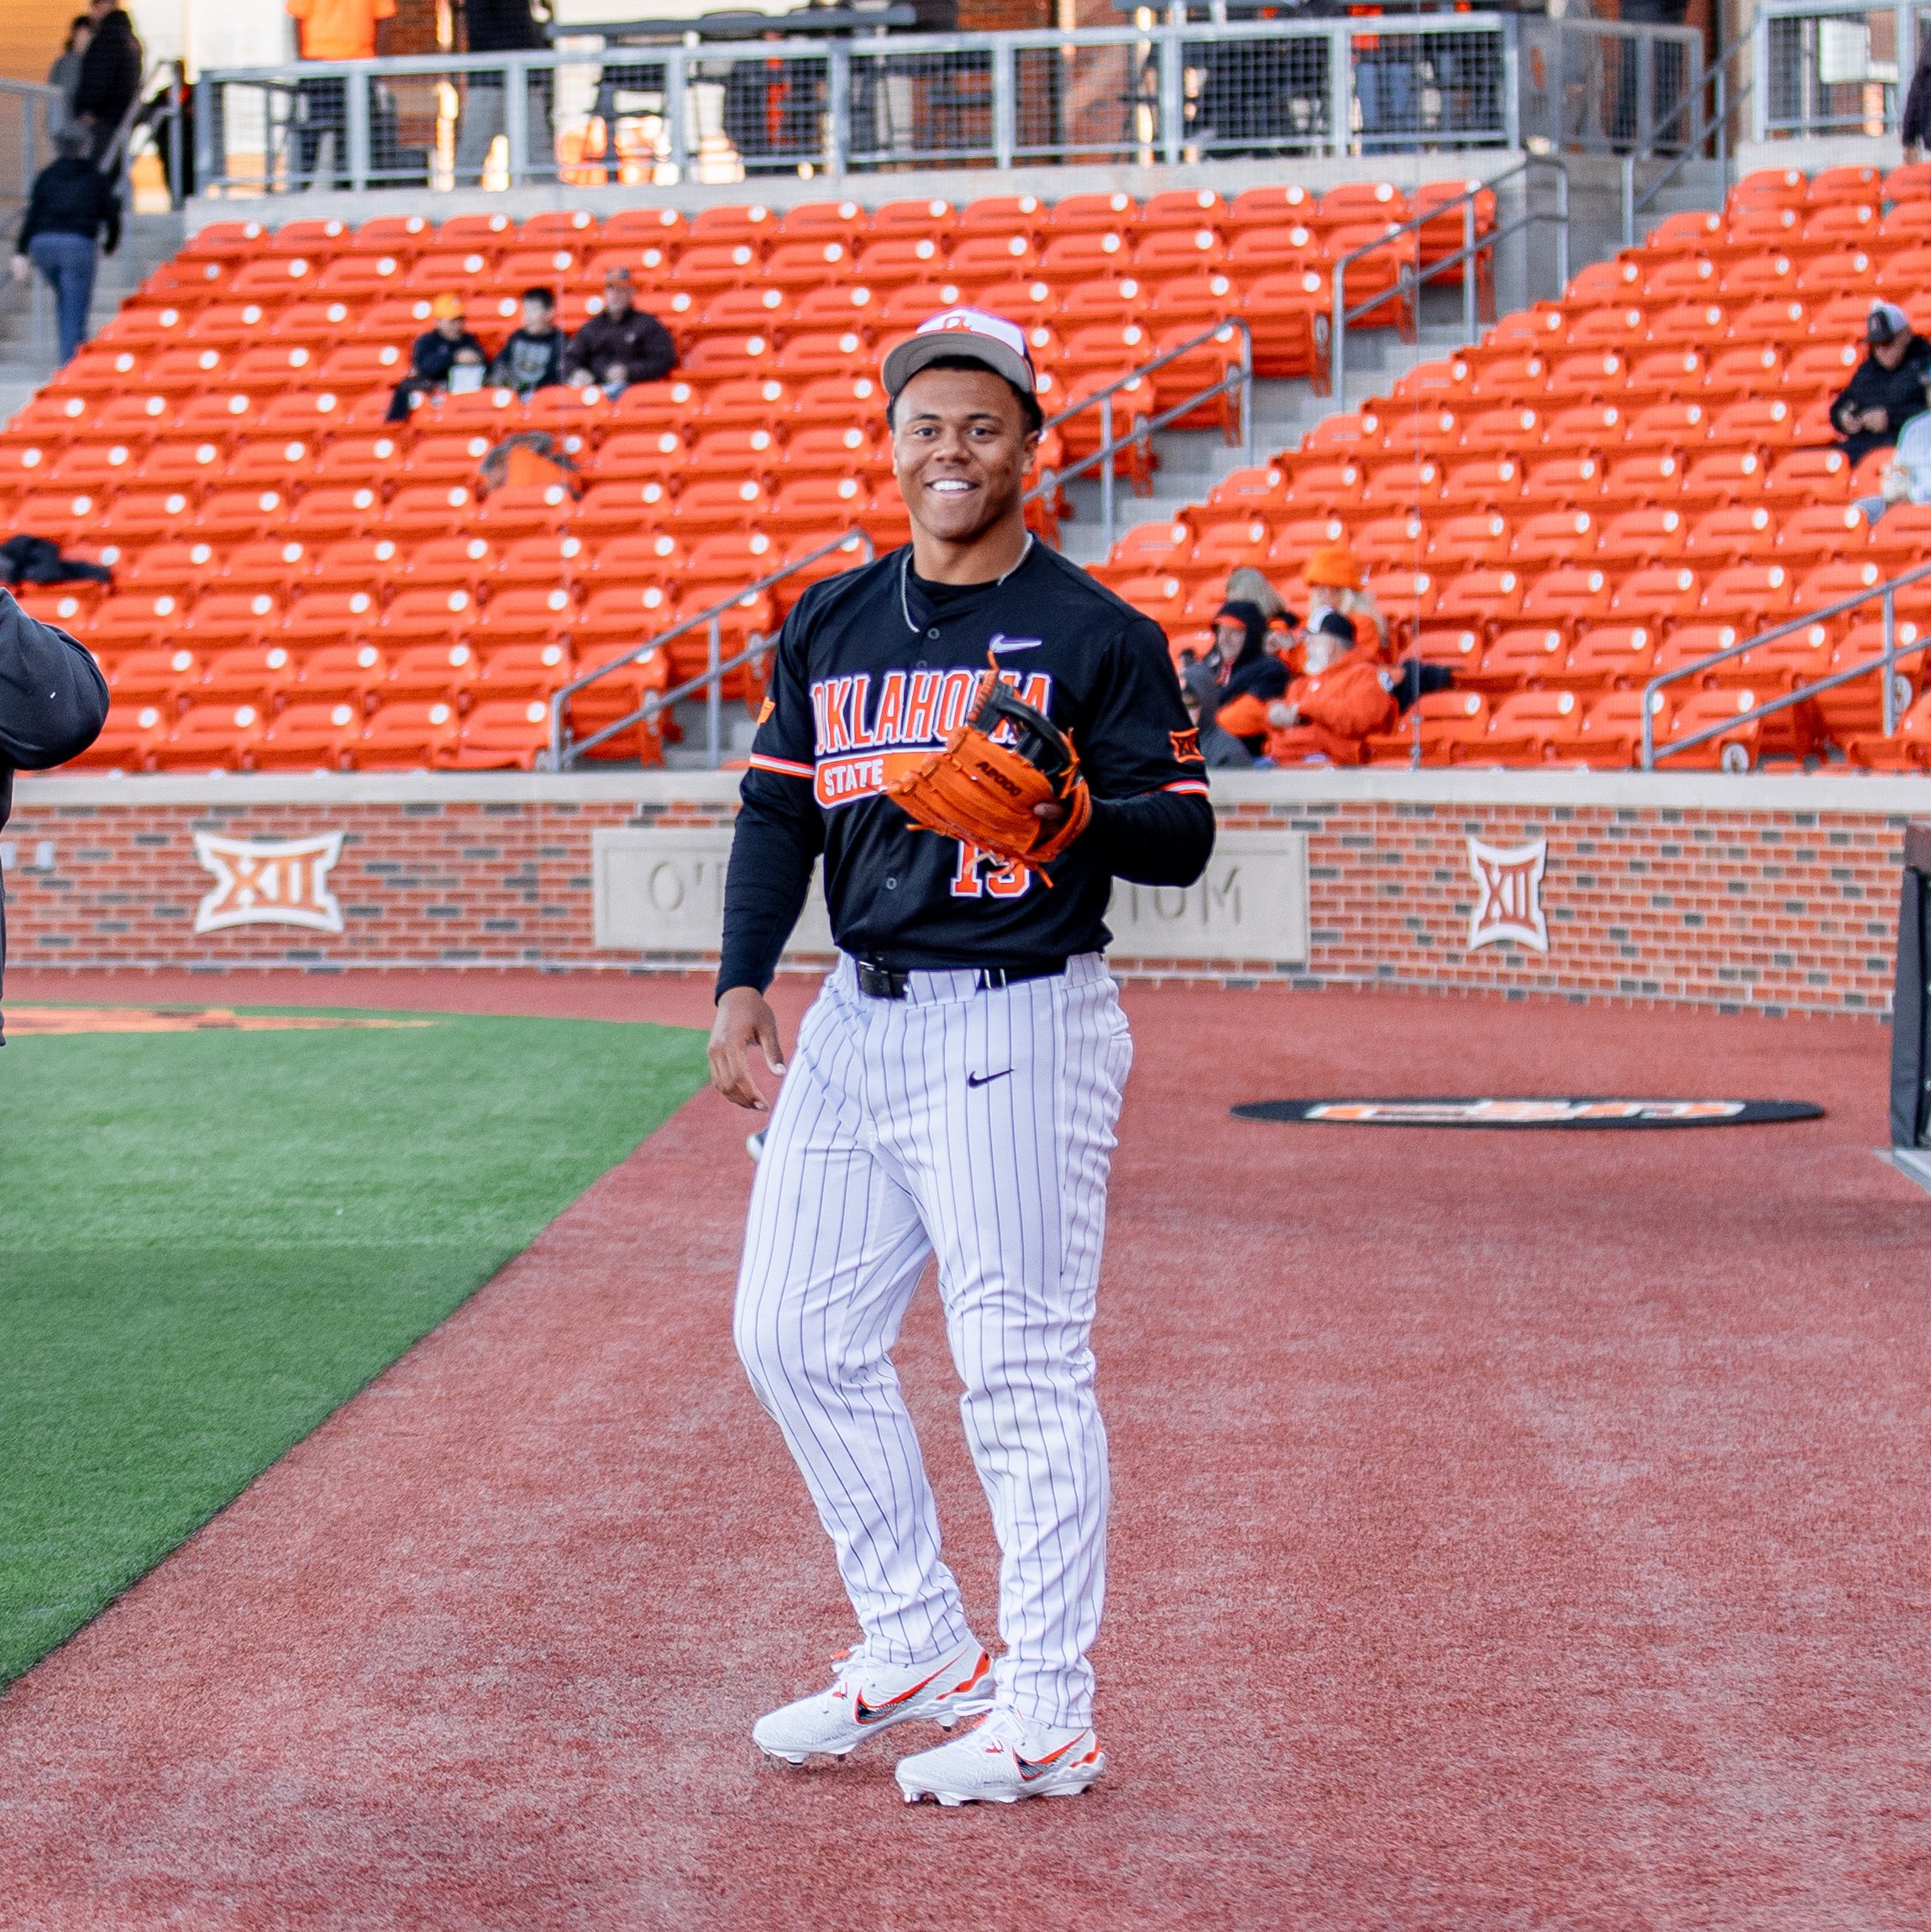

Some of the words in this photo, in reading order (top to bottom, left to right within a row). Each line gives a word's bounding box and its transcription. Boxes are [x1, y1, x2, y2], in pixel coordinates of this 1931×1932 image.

[824, 759, 884, 797] STATE
[210, 848, 327, 916] XII
[1477, 857, 1537, 933] XII
